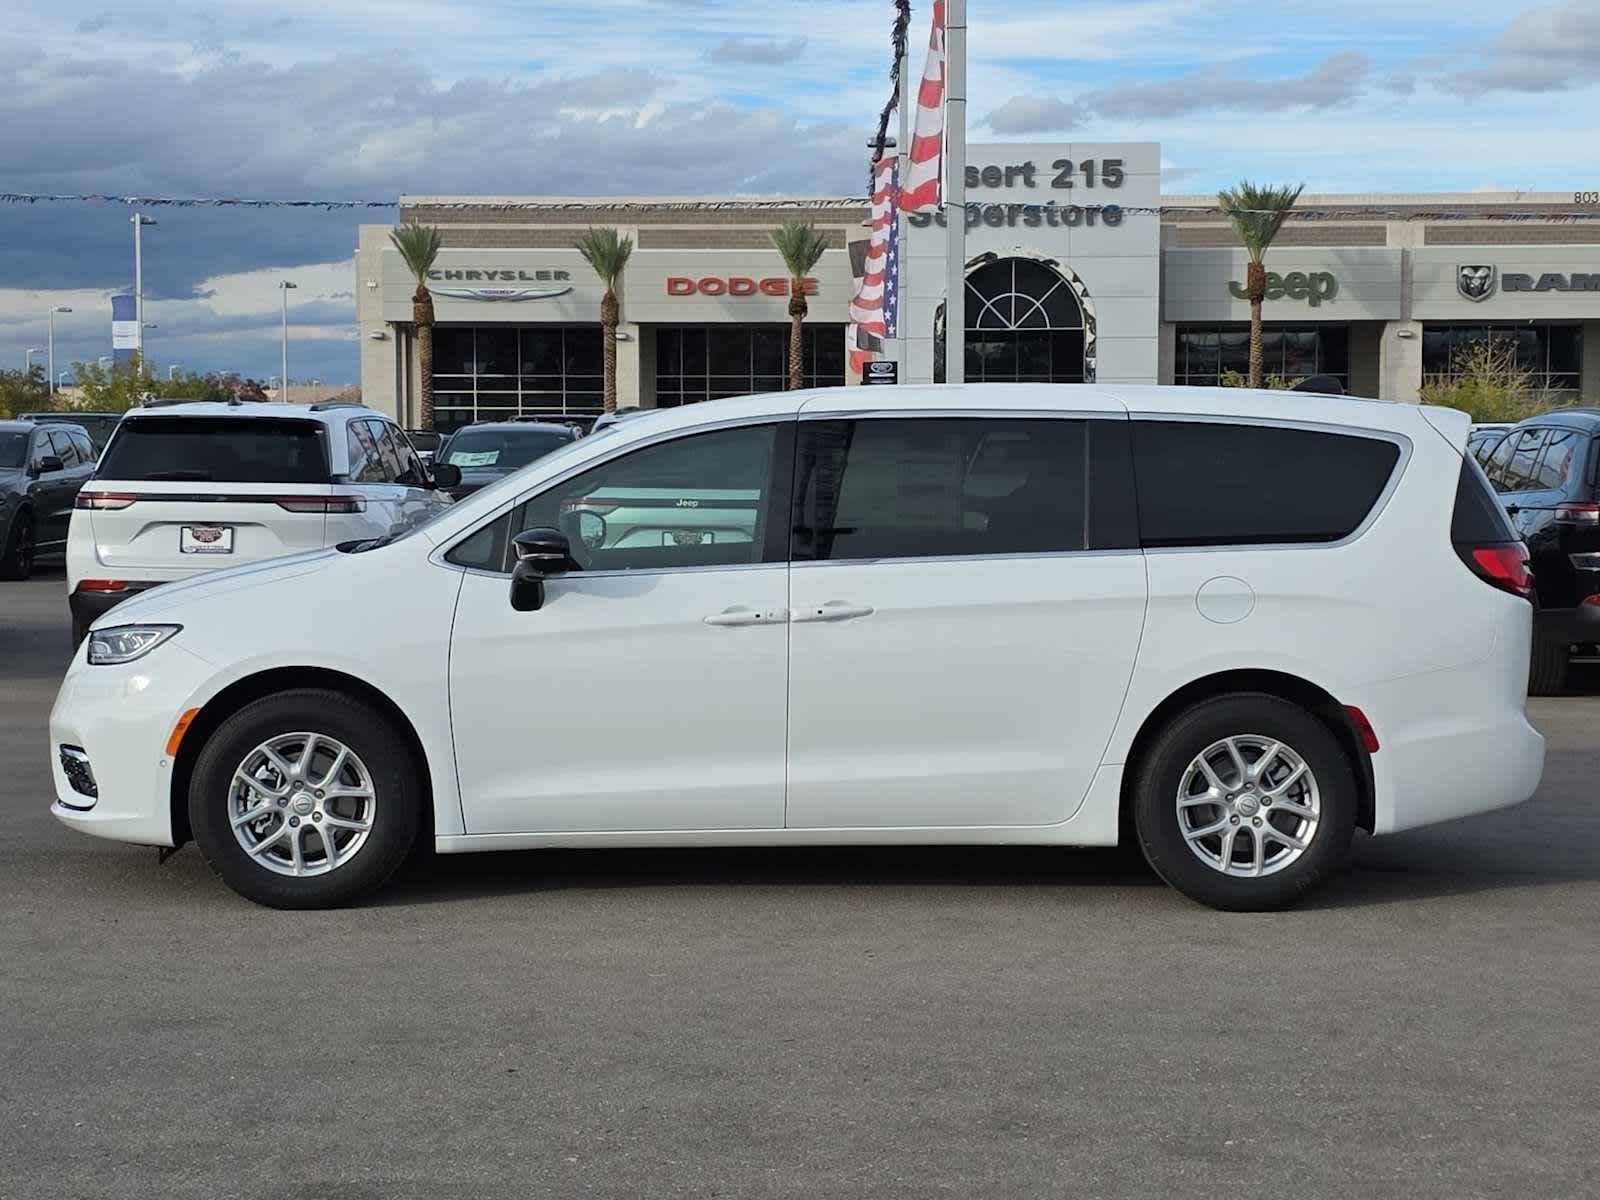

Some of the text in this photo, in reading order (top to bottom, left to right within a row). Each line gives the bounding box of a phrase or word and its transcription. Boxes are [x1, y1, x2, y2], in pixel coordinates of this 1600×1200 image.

[965, 159, 1124, 188] sert 215
[1574, 192, 1600, 204] 803
[427, 269, 571, 281] CHRYSLER
[1502, 273, 1600, 292] RAM
[667, 277, 819, 296] DODGE
[676, 498, 699, 508] Jeep
